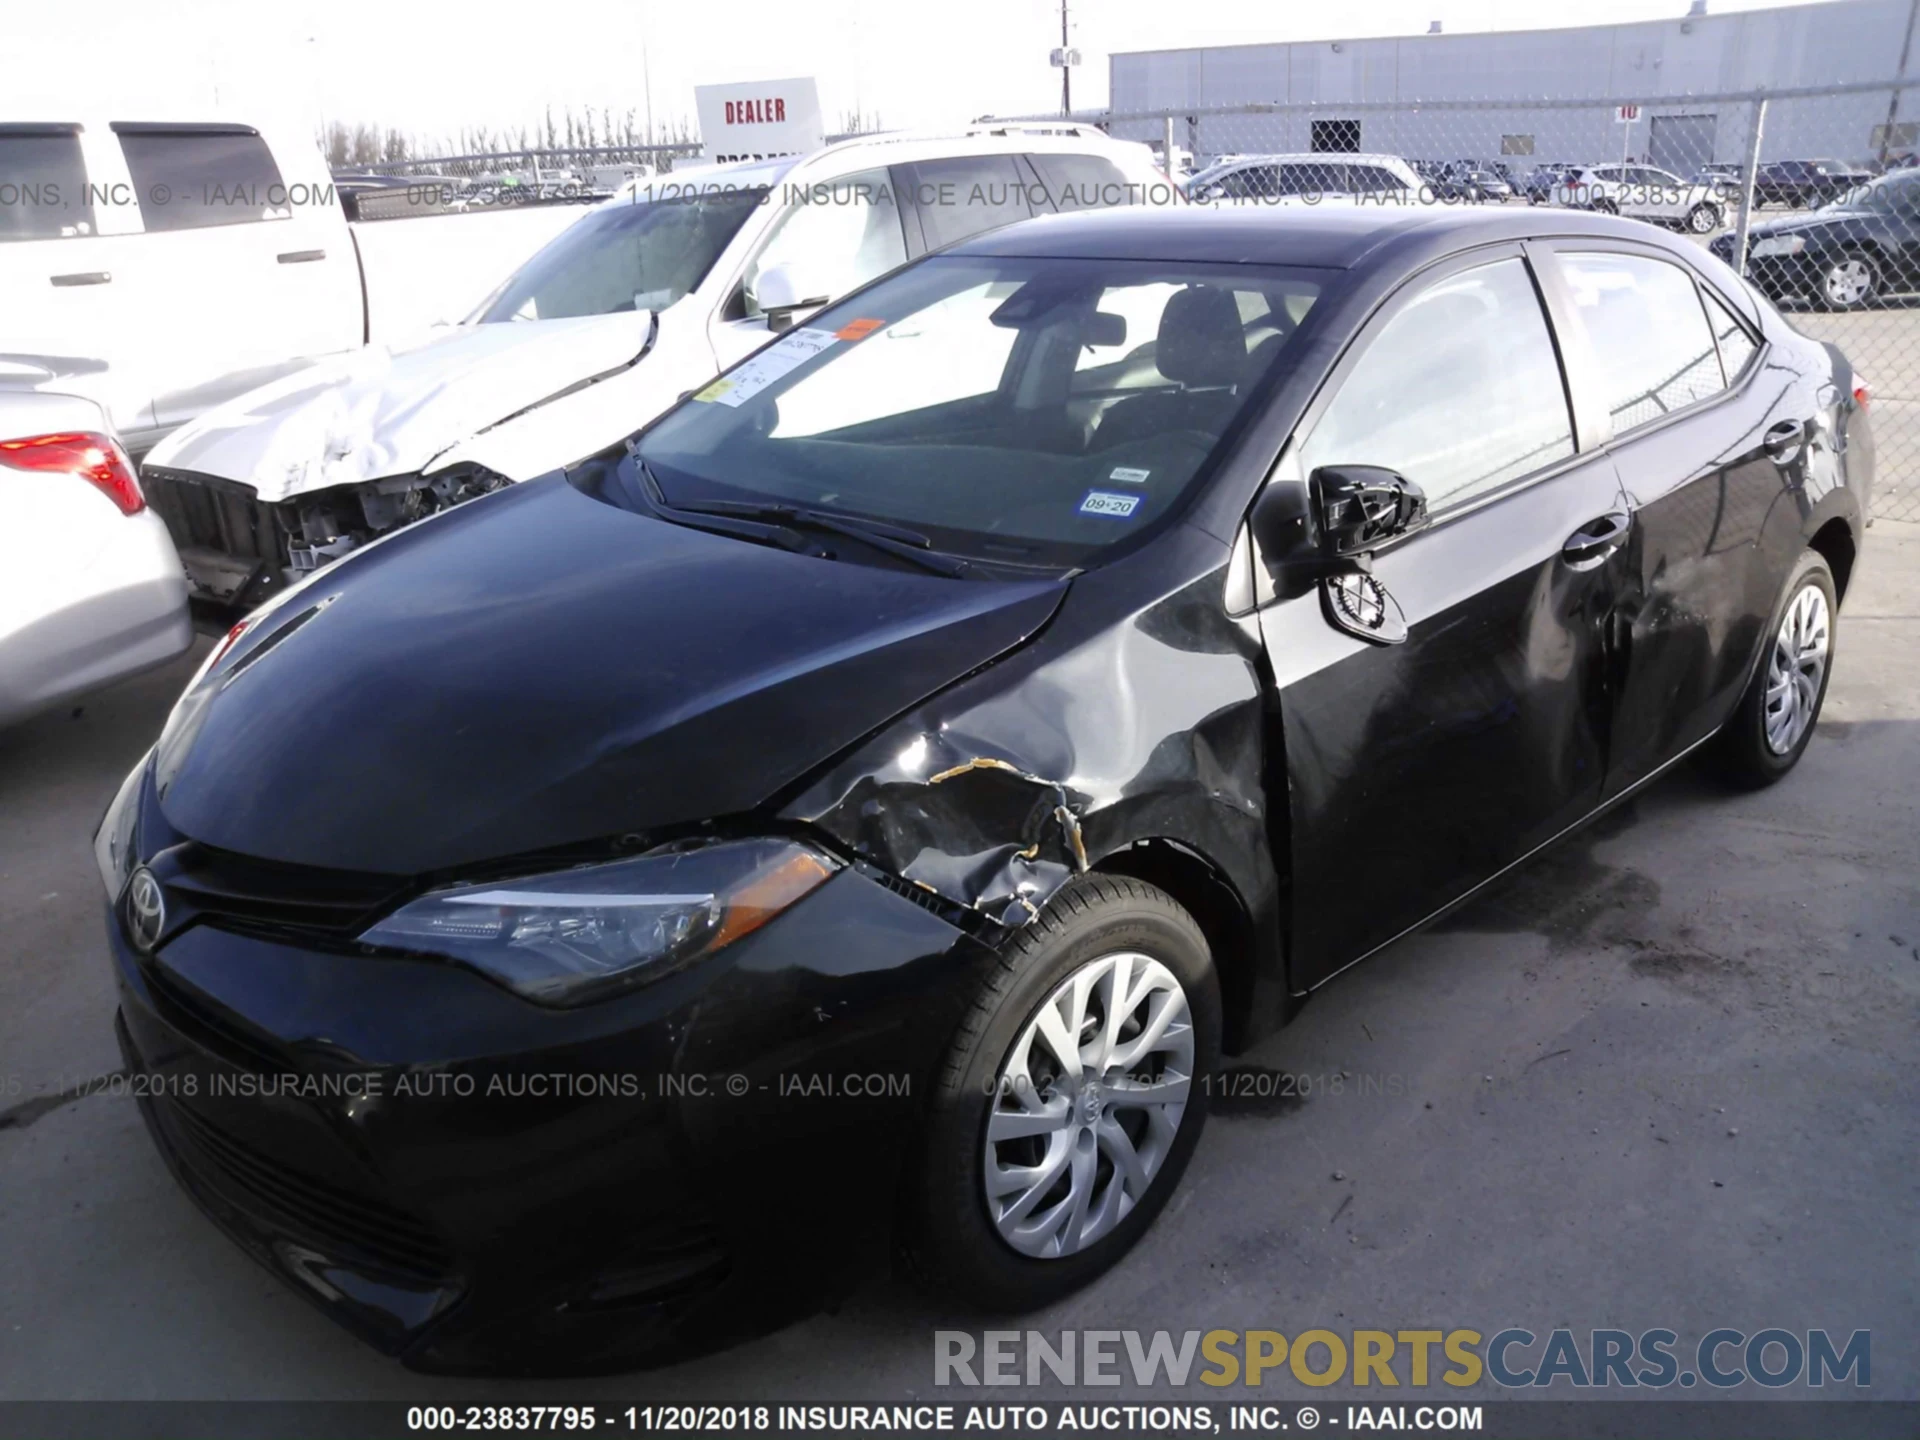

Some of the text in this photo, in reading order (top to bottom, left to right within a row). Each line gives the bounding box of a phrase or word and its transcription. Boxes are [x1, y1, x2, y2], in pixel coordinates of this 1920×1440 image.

[725, 98, 786, 125] DEALER
[1085, 499, 1106, 510] 09
[1110, 501, 1131, 513] 20
